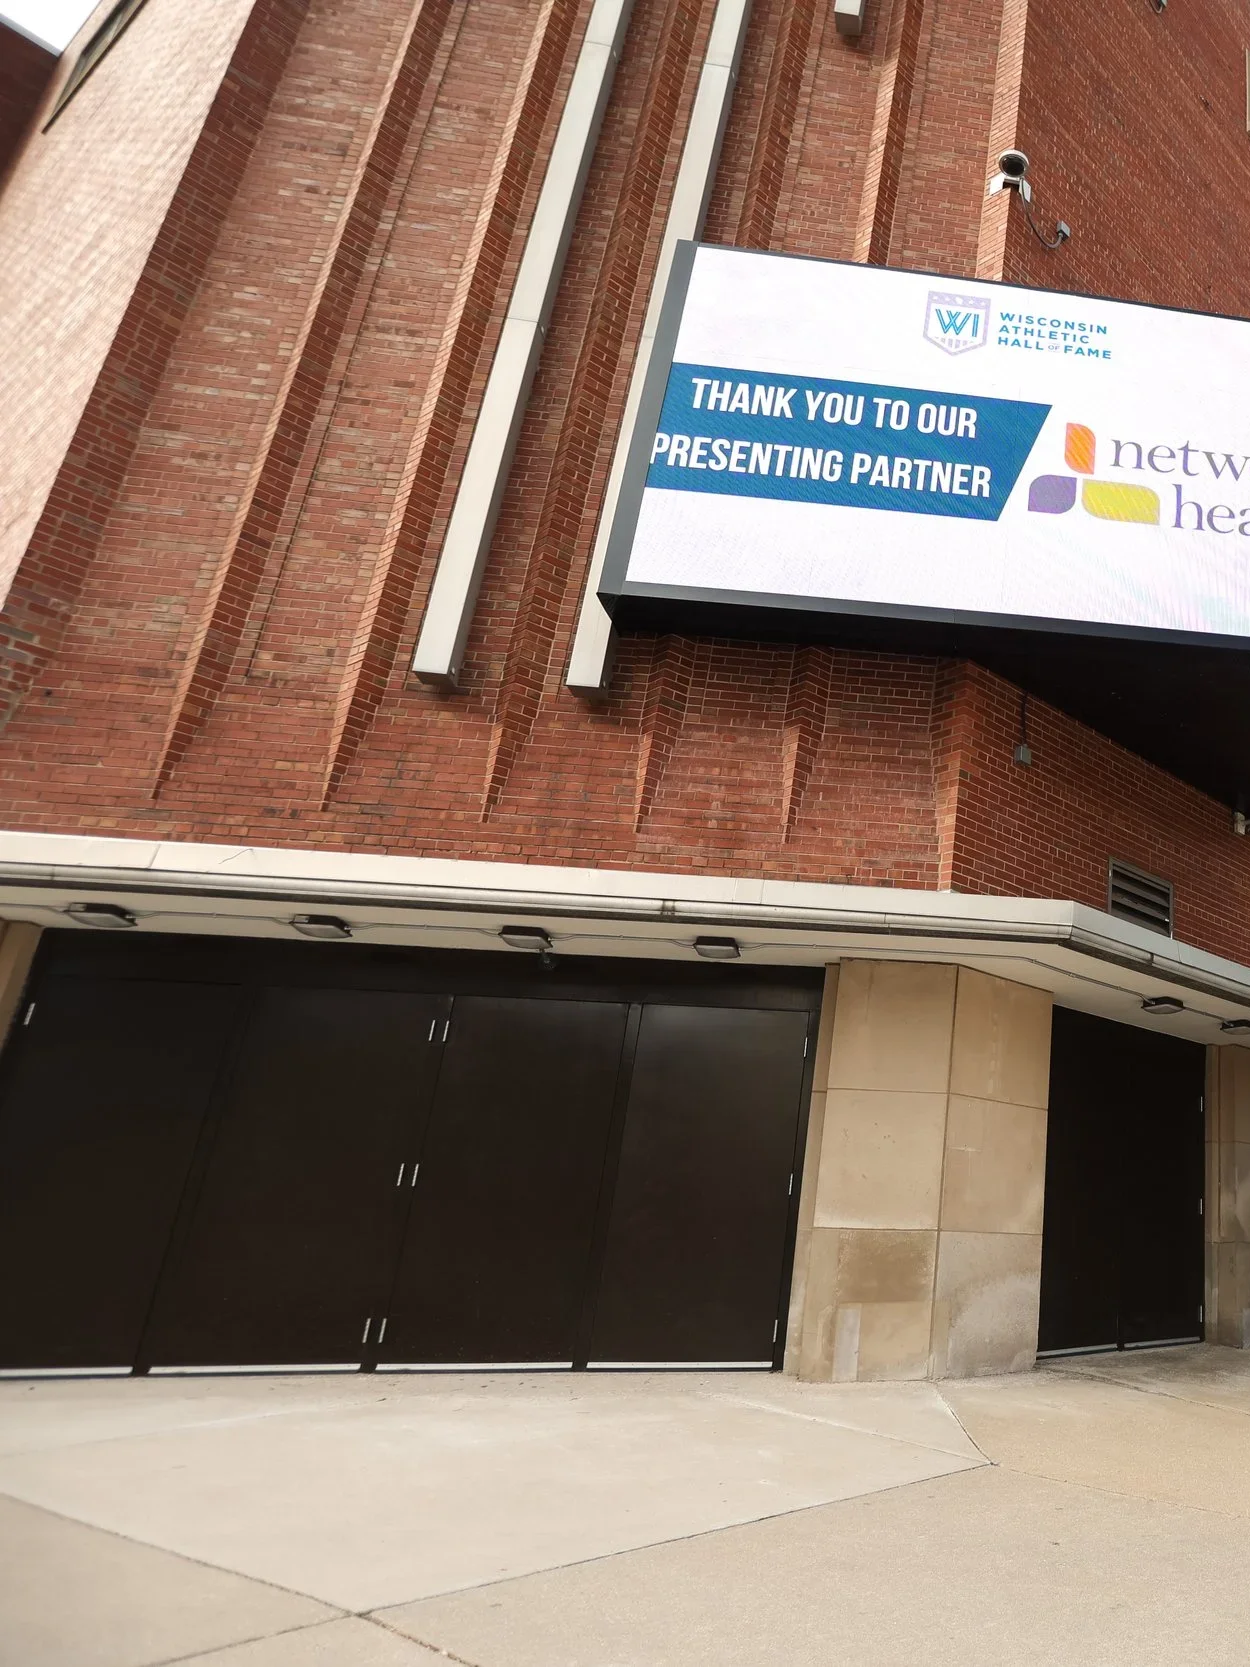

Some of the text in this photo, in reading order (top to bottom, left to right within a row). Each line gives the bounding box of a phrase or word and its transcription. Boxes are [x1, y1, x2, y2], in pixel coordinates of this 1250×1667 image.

[999, 312, 1108, 335] WISCONSIN
[999, 324, 1090, 345] ATHLETIC
[998, 336, 1112, 360] HALL OF FAME
[691, 377, 978, 438] THANK YOU TO OUR
[649, 432, 992, 498] PRESENTING PARTNER
